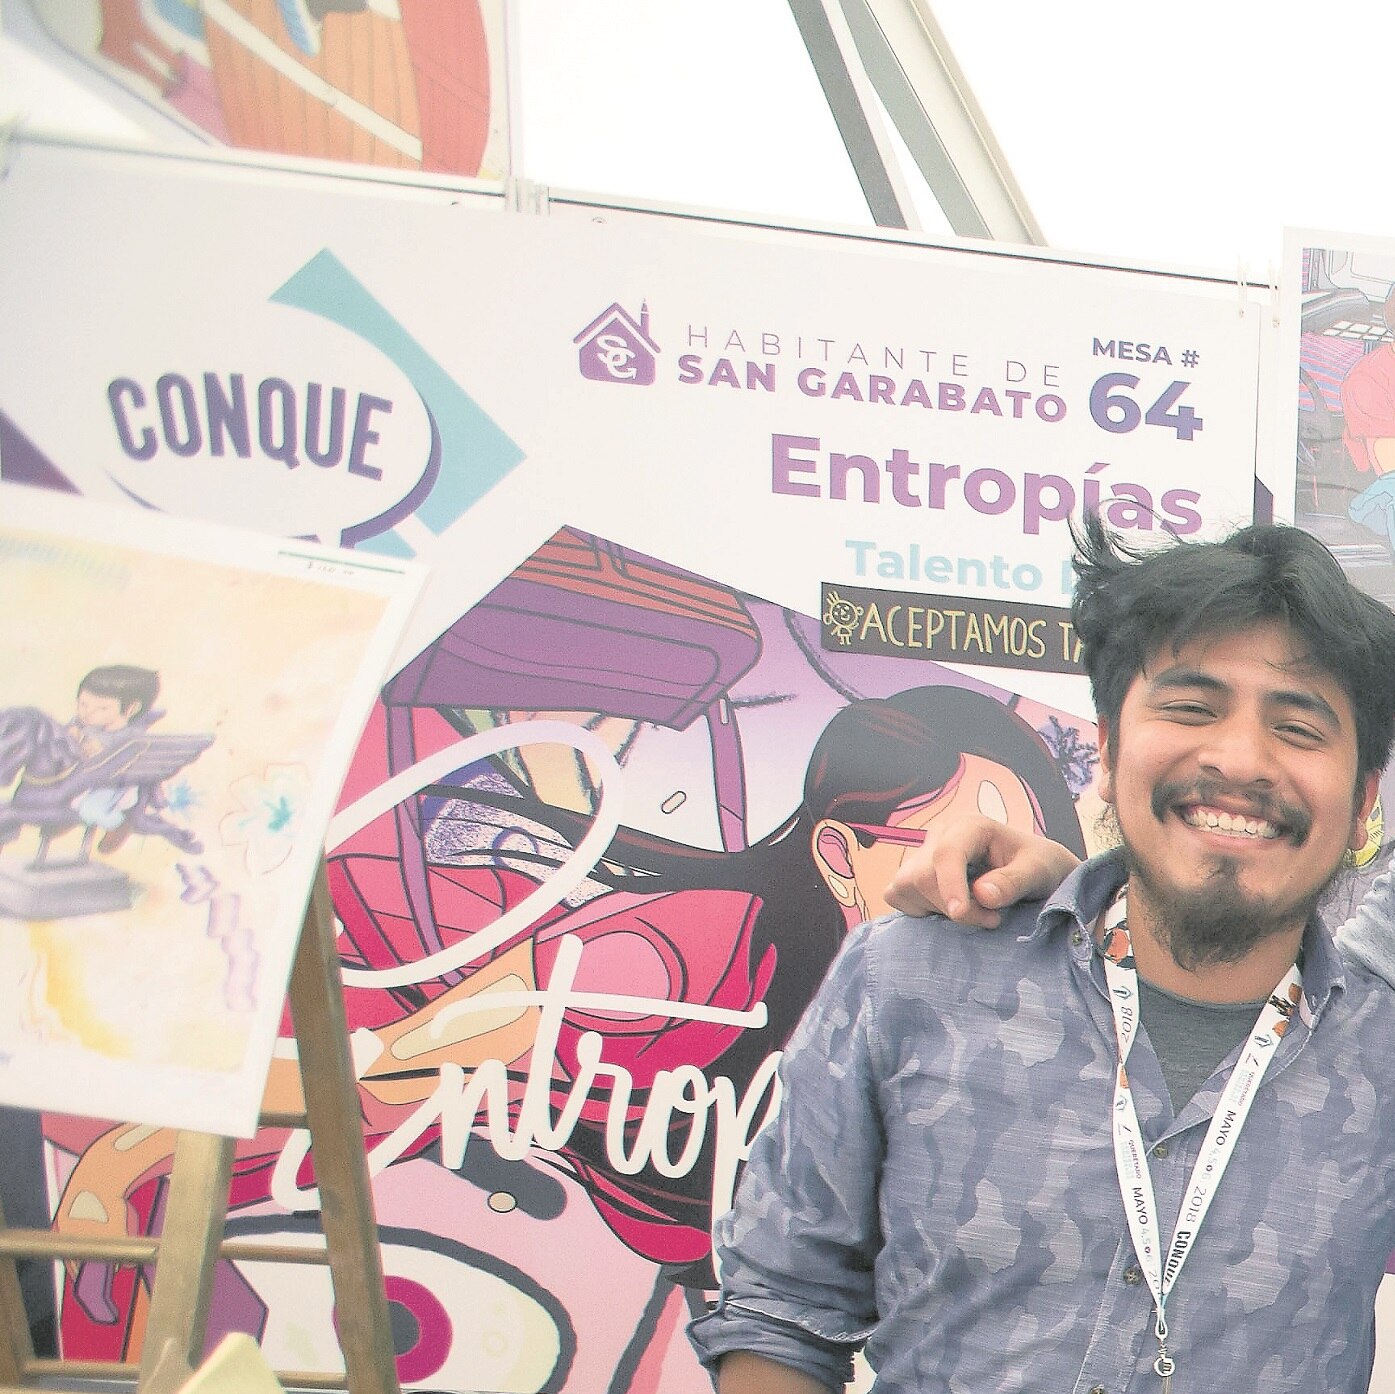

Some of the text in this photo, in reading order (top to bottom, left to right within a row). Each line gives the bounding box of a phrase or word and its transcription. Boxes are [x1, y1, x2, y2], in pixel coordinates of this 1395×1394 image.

[688, 324, 1061, 388] HABITANTE DE
[1092, 336, 1200, 369] MESA #
[678, 355, 1068, 423] SAN GARABATO
[1089, 373, 1204, 441] 64
[106, 371, 394, 482] CONQUE
[771, 432, 1203, 536] Entropías
[845, 540, 1043, 593] Talento
[861, 603, 1047, 660] ACEPTAMOS
[1215, 1109, 1237, 1147] MAYO
[1132, 1186, 1148, 1226] MAYO
[1185, 1185, 1207, 1223] 2018
